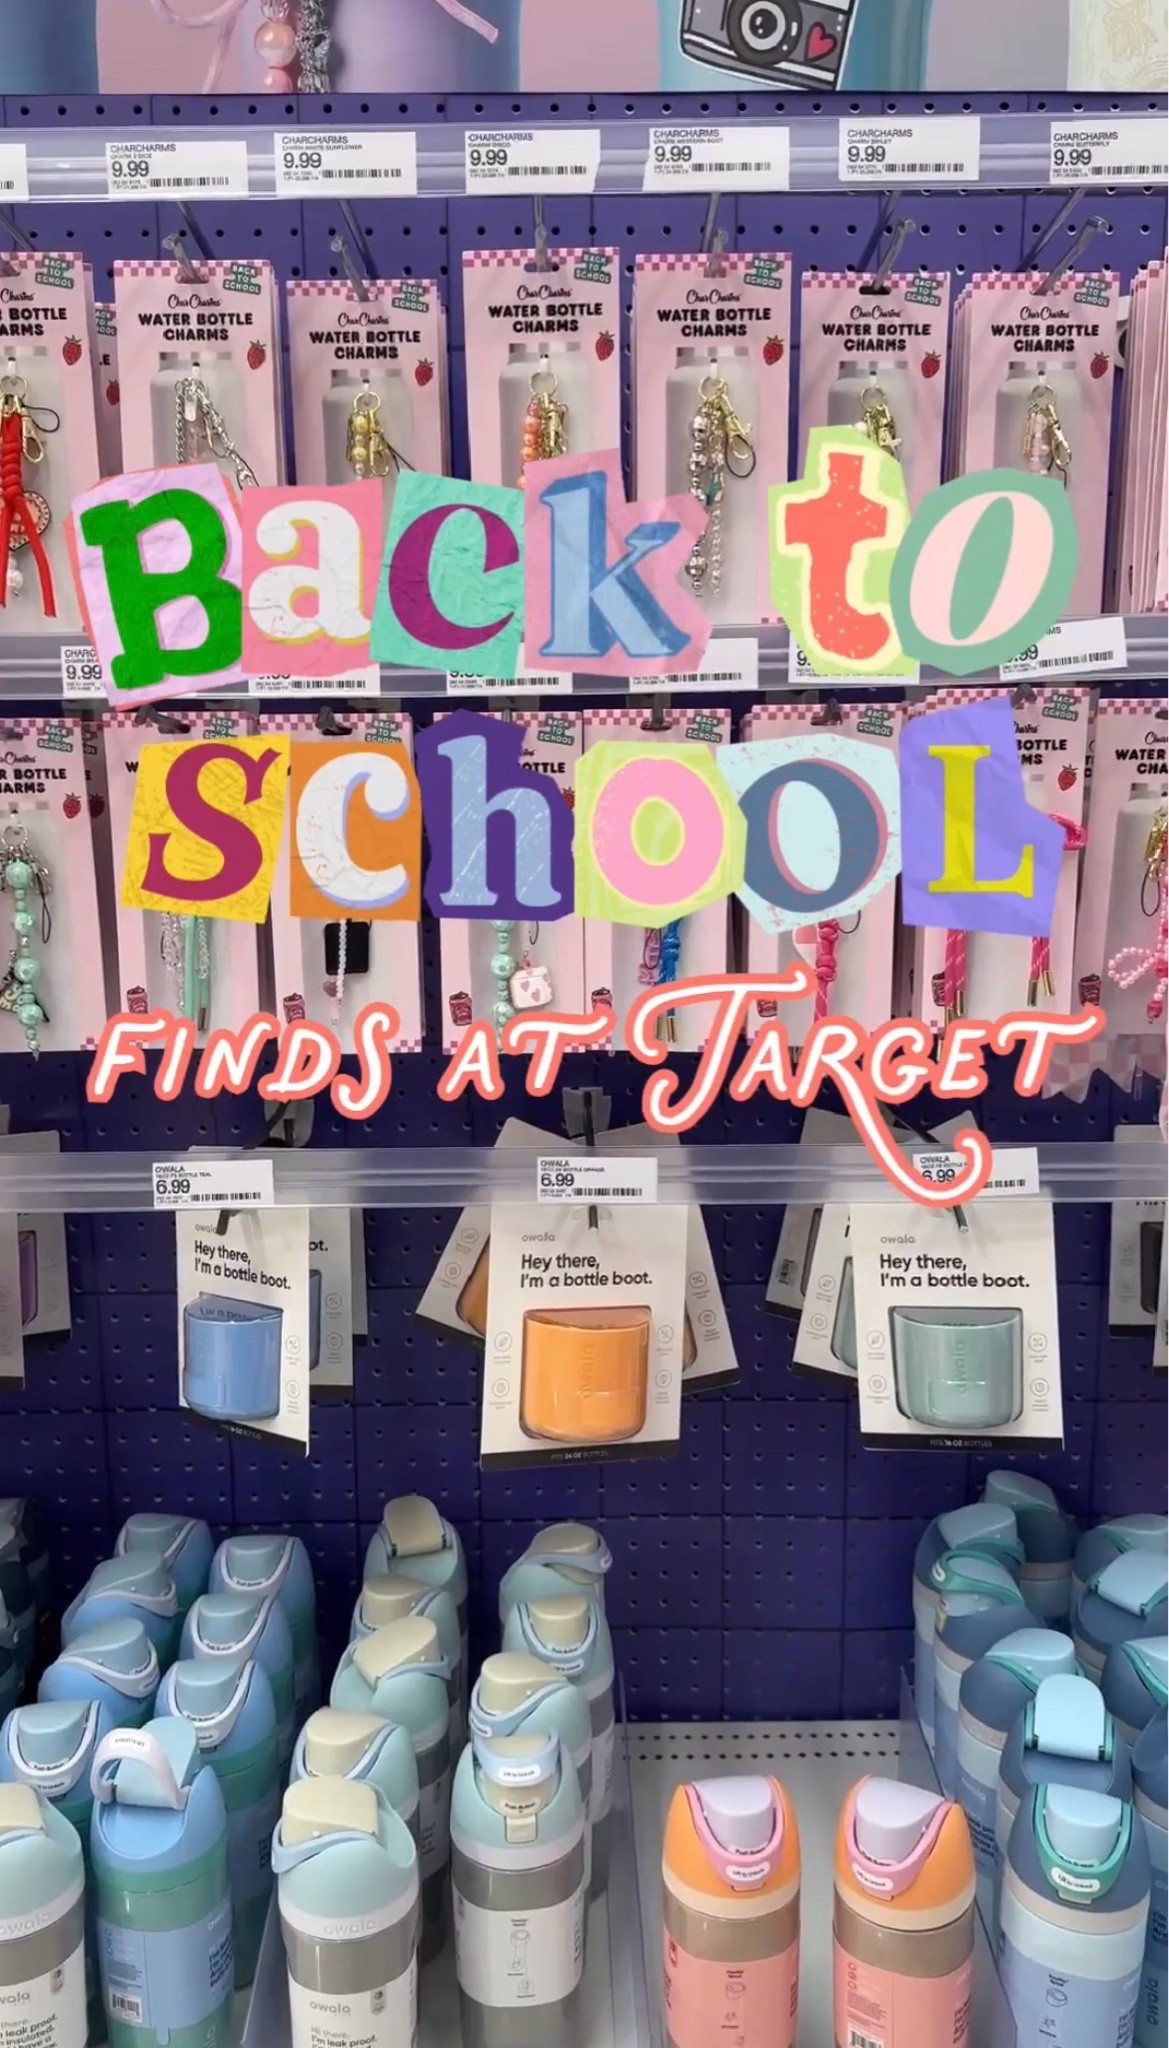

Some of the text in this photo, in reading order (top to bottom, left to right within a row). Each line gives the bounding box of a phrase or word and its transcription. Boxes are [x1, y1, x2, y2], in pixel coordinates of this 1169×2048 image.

[468, 133, 533, 142] CHARCHARMS
[654, 129, 720, 138] CHARCHARMS
[847, 129, 913, 138] CHARCHARMS
[1053, 132, 1118, 141] CHARCHARMS
[282, 136, 348, 144] CHARCHARMS
[110, 144, 176, 153] CHARCHARMS
[654, 145, 692, 162] 9.99
[848, 145, 886, 162] 9.99
[283, 152, 322, 169] 9.99
[470, 149, 508, 166] 9.99
[1053, 149, 1092, 166] 9.99
[112, 160, 149, 177] 9.99
[44, 257, 68, 269] BACK
[584, 253, 607, 265] BACK
[753, 258, 778, 269] BACK
[50, 267, 61, 276] TO
[231, 265, 256, 276] BACK
[589, 263, 600, 271] TO
[755, 268, 769, 277] TO
[37, 274, 73, 288] SCHOOL
[575, 269, 611, 283] SCHOOL
[745, 275, 782, 289] SCHOOL
[224, 280, 261, 294] SCHOOL
[914, 278, 938, 288] BACK
[1084, 279, 1106, 289] BACK
[401, 284, 424, 295] BACK
[918, 286, 930, 295] TO
[1088, 288, 1099, 296] TO
[406, 293, 417, 301] TO
[906, 292, 942, 306] SCHOOL
[1074, 294, 1109, 306] SCHOOL
[392, 298, 429, 312] SCHOOL
[488, 303, 602, 318] WATER BOTTLE
[9, 308, 67, 320] BOTTLE
[138, 312, 253, 325] WATER BOTTLE
[657, 307, 771, 322] WATER BOTTLE
[513, 319, 579, 333] CHARMS
[681, 324, 747, 337] CHARMS
[822, 323, 931, 336] WATER BOTTLE
[991, 324, 1099, 336] WATER BOTTLE
[163, 328, 228, 341] CHARMS
[309, 330, 421, 344] WATER BOTTLE
[844, 338, 906, 352] CHARMS
[1014, 339, 1075, 352] CHARMS
[334, 346, 398, 359] CHARMS
[66, 664, 102, 680] 9.99
[867, 709, 889, 719] BACK
[212, 718, 234, 727] BACK
[373, 721, 397, 730] BACK
[547, 719, 570, 729] BACK
[695, 716, 718, 725] BACK
[870, 717, 883, 725] TO
[552, 726, 563, 735] TO
[701, 724, 711, 732] TO
[858, 723, 892, 736] SCHOOL
[538, 733, 574, 745] SCHOOL
[687, 730, 722, 742] SCHOOL
[39, 740, 72, 752] SCHOOL
[1115, 749, 1166, 760] WATER
[14, 769, 67, 780] BOTTLE
[920, 1155, 950, 1164] OWALA
[541, 1173, 574, 1187] 6.99
[156, 1179, 190, 1194] 6.99
[521, 1232, 555, 1242] owala
[880, 1234, 915, 1244] owala
[195, 1240, 251, 1264] Hey there,
[521, 1254, 600, 1272] Hey there,
[880, 1254, 967, 1271] Hey there,
[195, 1257, 291, 1289] I'm a bottle boot.
[521, 1271, 653, 1288] I'm a bottle boot.
[881, 1272, 1030, 1287] I'm a bottle boot.
[309, 2001, 351, 2013] owala
[5, 2013, 58, 2037] leak proof.
[311, 2034, 378, 2047] I'm leak proof.
